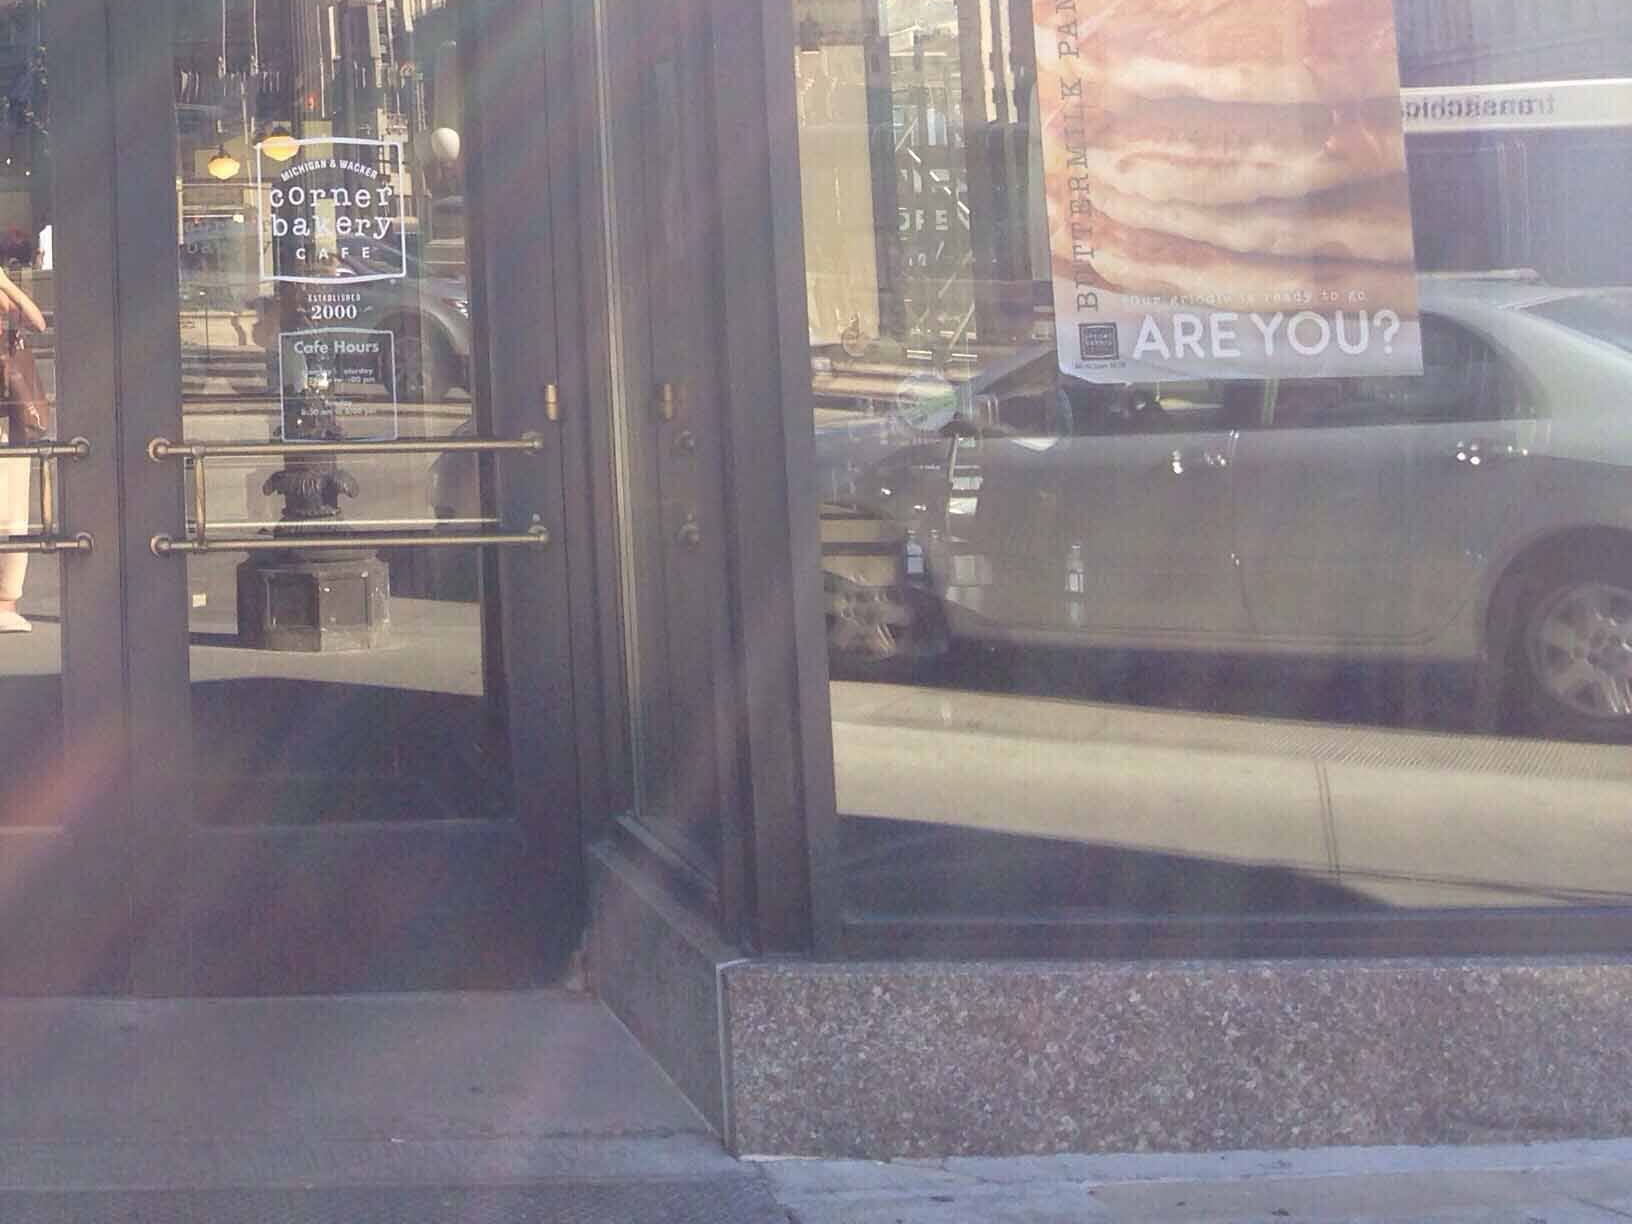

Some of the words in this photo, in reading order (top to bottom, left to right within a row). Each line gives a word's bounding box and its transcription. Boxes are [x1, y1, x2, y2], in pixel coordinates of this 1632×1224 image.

[280, 159, 327, 182] MICHIGAN
[339, 159, 378, 180] WACKER
[270, 185, 393, 208] corner
[1060, 77, 1099, 312] BUTTERMILK
[270, 214, 393, 240] bakery
[296, 247, 371, 260] CAFE
[311, 305, 357, 320] 2000
[1133, 312, 1241, 360] ARE
[1249, 308, 1401, 356] YOU?
[294, 340, 329, 354] Cafe
[334, 340, 380, 353] Hours
